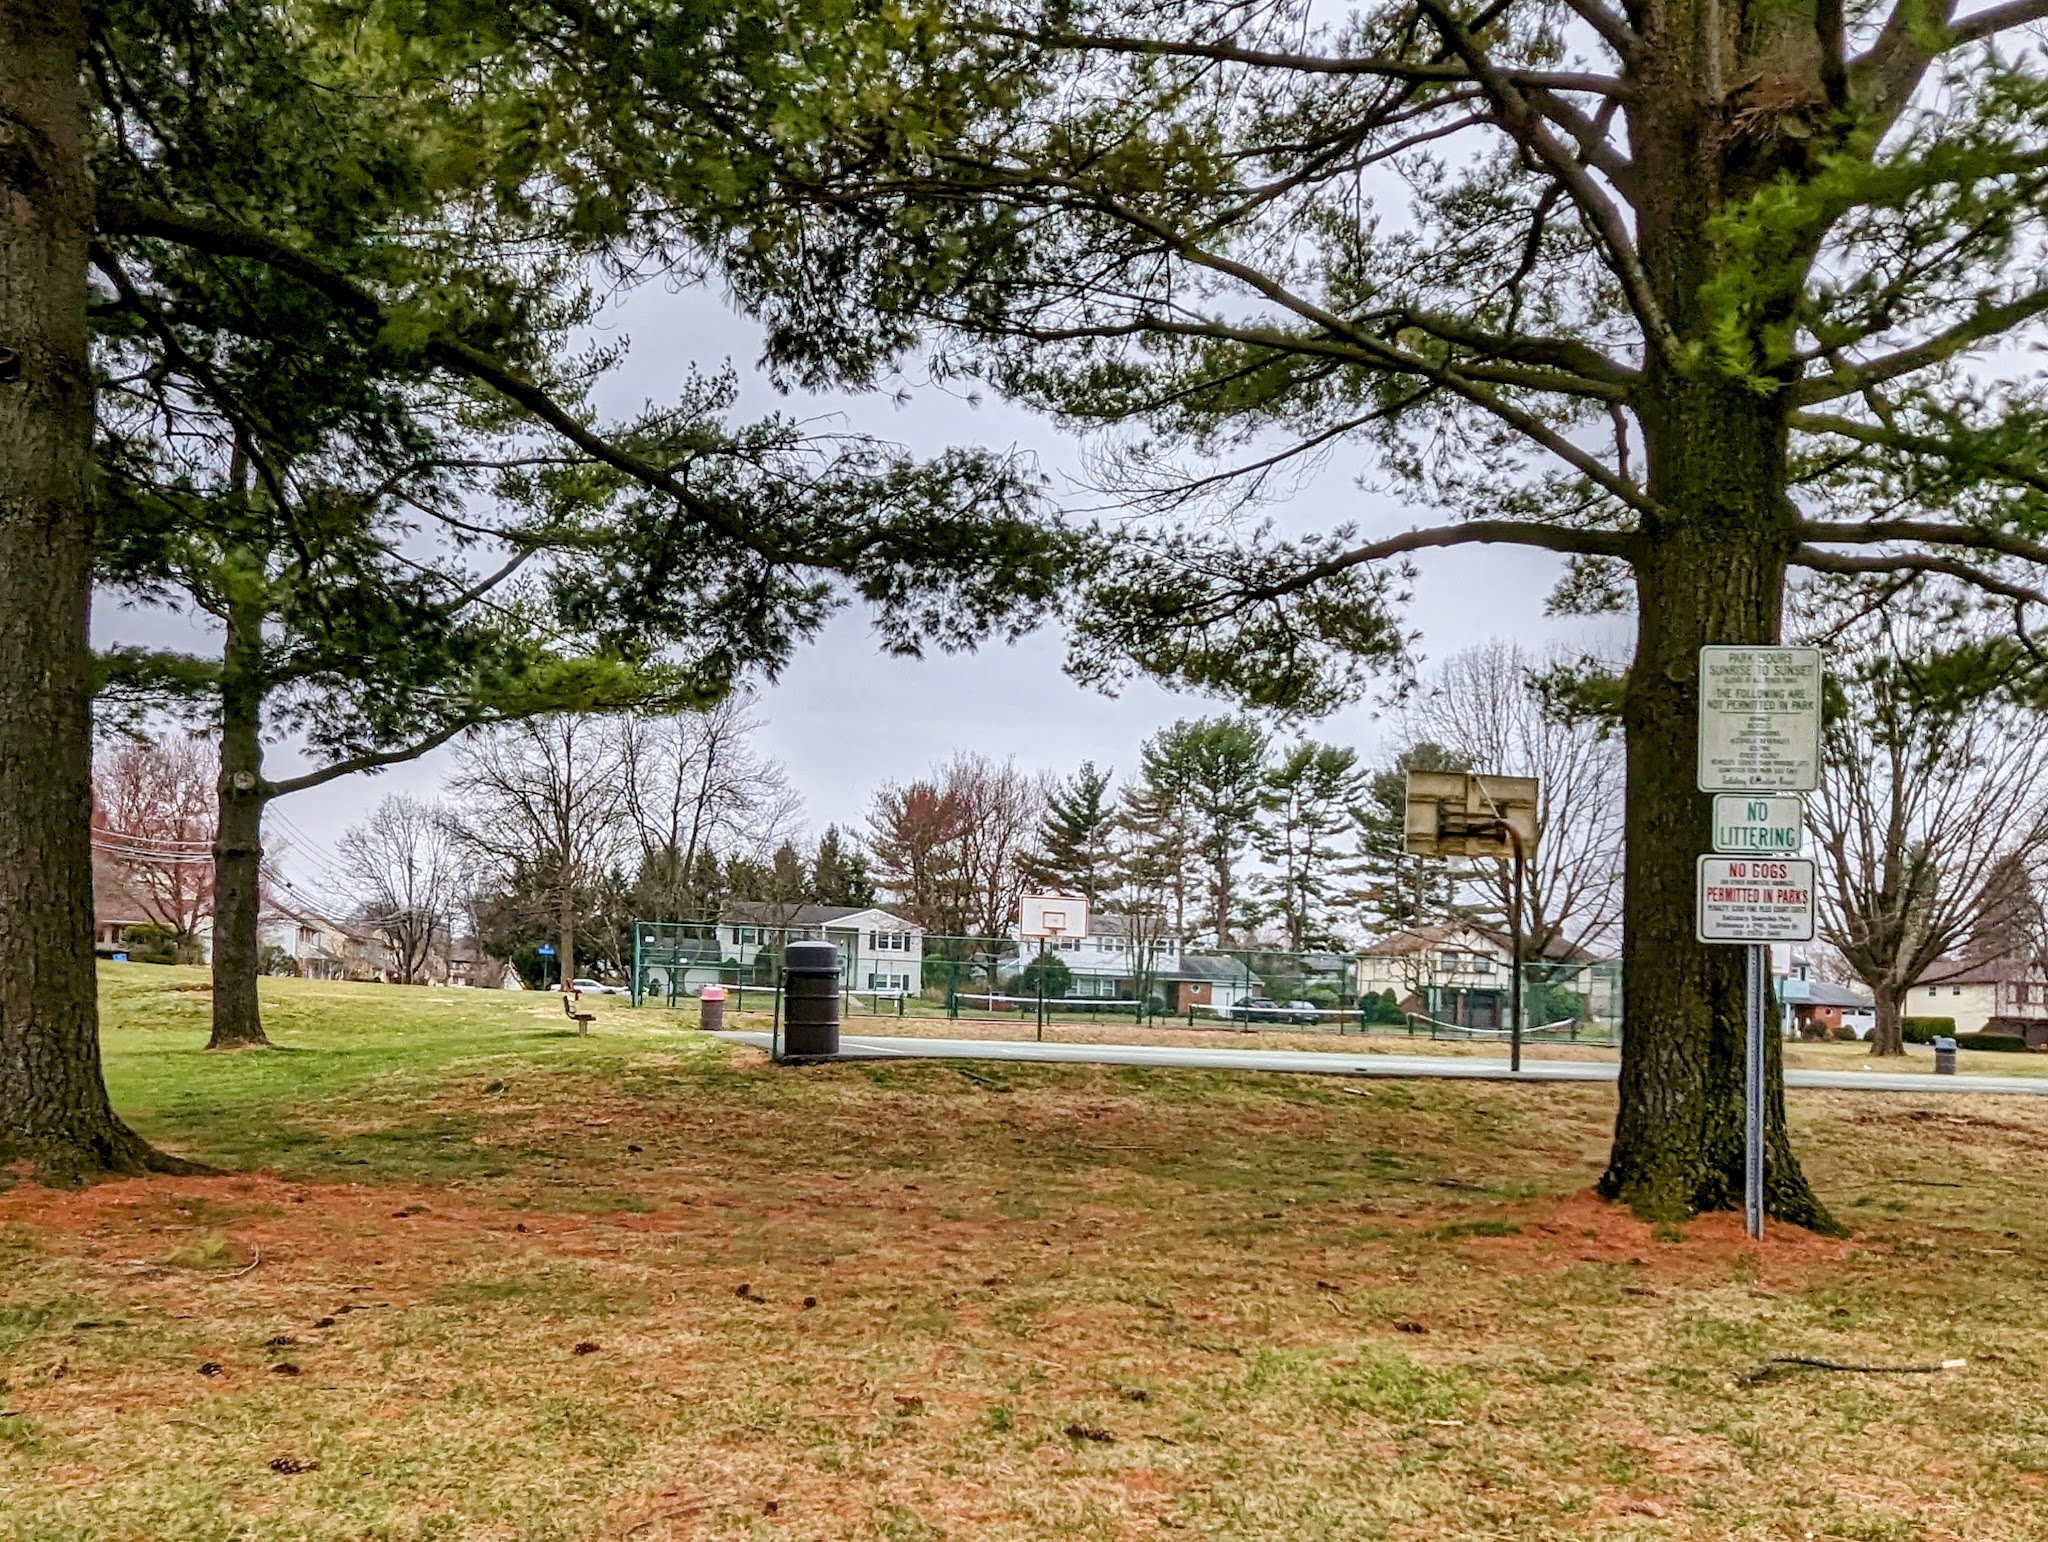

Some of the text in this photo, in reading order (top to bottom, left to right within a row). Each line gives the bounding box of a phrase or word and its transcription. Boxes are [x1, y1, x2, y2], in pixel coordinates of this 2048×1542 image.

[1729, 653, 1792, 664] PARK HOURS
[1710, 666, 1811, 675] SUNRISE TO SUNSET
[1717, 689, 1805, 698] THE FOLLOWING ARE
[1708, 701, 1814, 710] NOT PERMITTED IN PARK
[1748, 802, 1768, 821] NO
[1721, 827, 1794, 846] LITTERING
[1729, 864, 1787, 878] NO DOGS
[1707, 887, 1808, 904] PERMITTED IN PARKS
